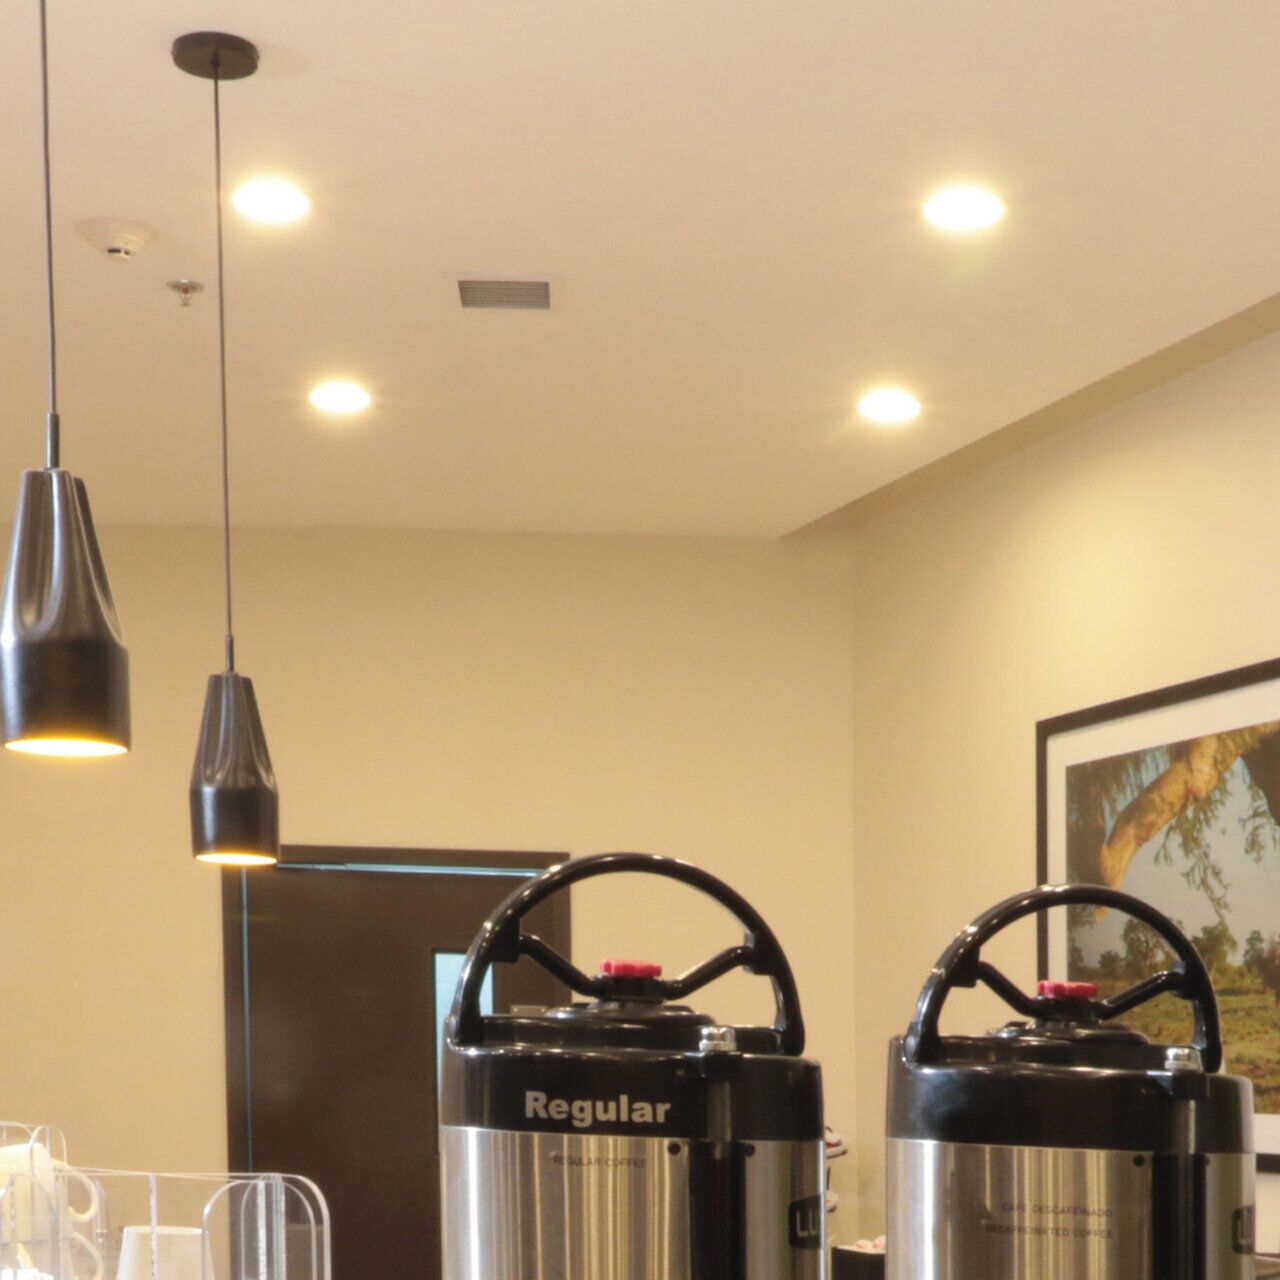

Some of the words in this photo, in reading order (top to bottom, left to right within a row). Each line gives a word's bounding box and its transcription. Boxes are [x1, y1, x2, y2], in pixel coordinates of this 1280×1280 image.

[524, 1090, 671, 1128] Regular
[553, 1155, 600, 1167] REGULAR
[604, 1157, 648, 1169] COFFEE
[985, 1224, 1070, 1237] DECAFFEINATED
[1073, 1228, 1113, 1240] COFFEE
